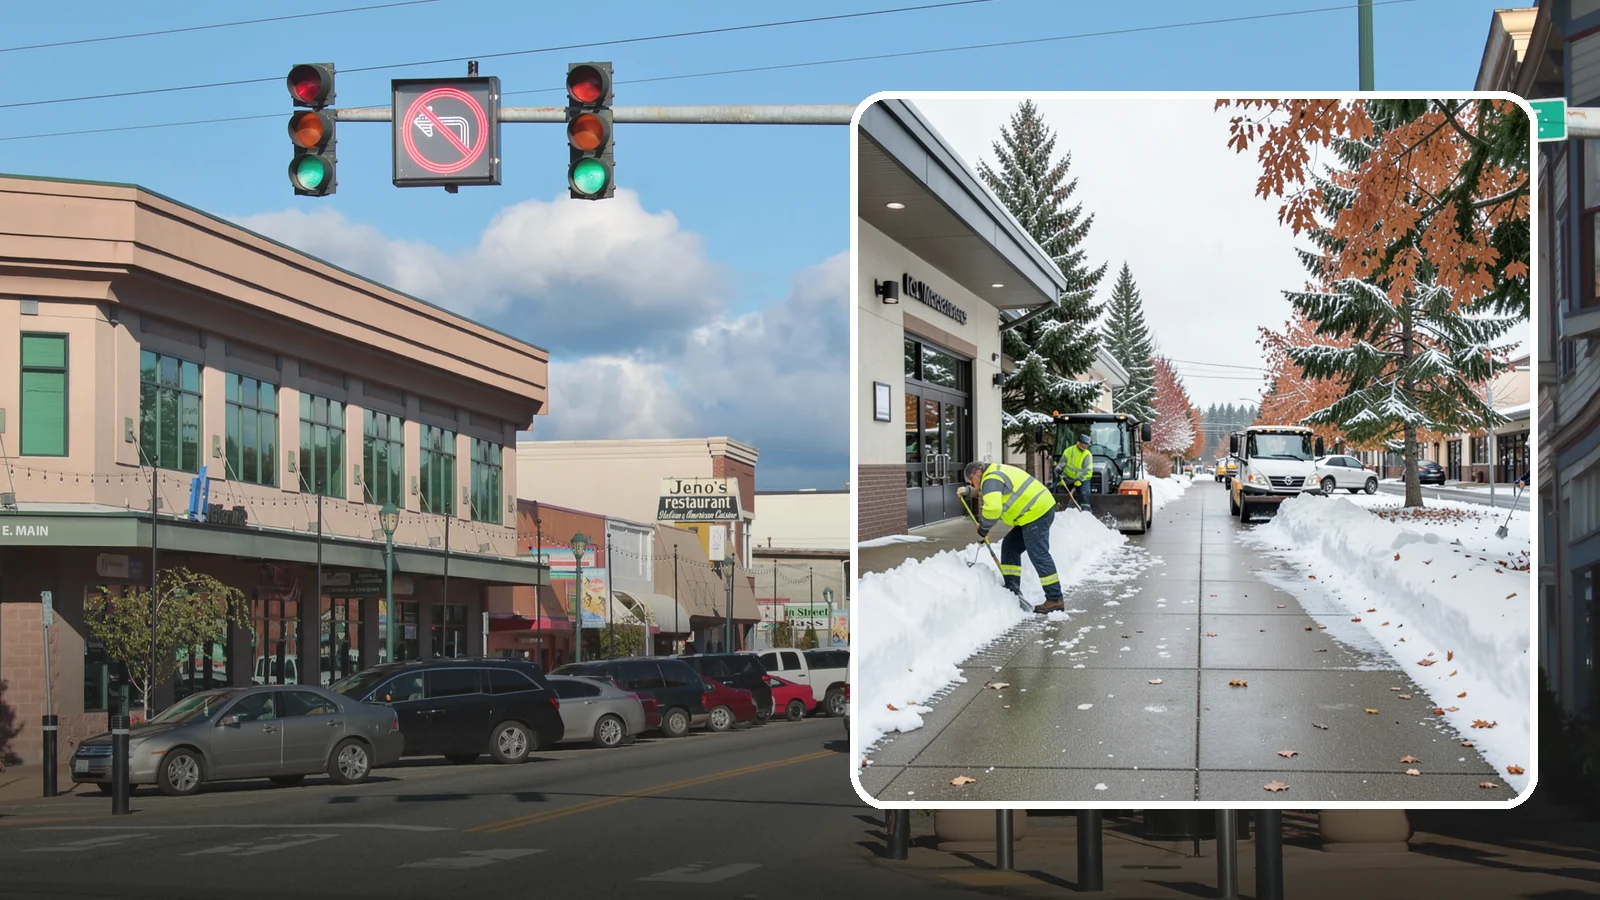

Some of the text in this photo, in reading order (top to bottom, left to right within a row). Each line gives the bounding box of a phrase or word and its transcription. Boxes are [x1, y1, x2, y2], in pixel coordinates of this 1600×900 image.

[669, 480, 728, 495] Jeno's
[665, 496, 731, 509] restaurant
[659, 510, 681, 520] Italian
[686, 510, 714, 519] American
[715, 510, 737, 519] Cuisine
[2, 525, 49, 536] E. MAIN
[797, 608, 828, 617] Street
